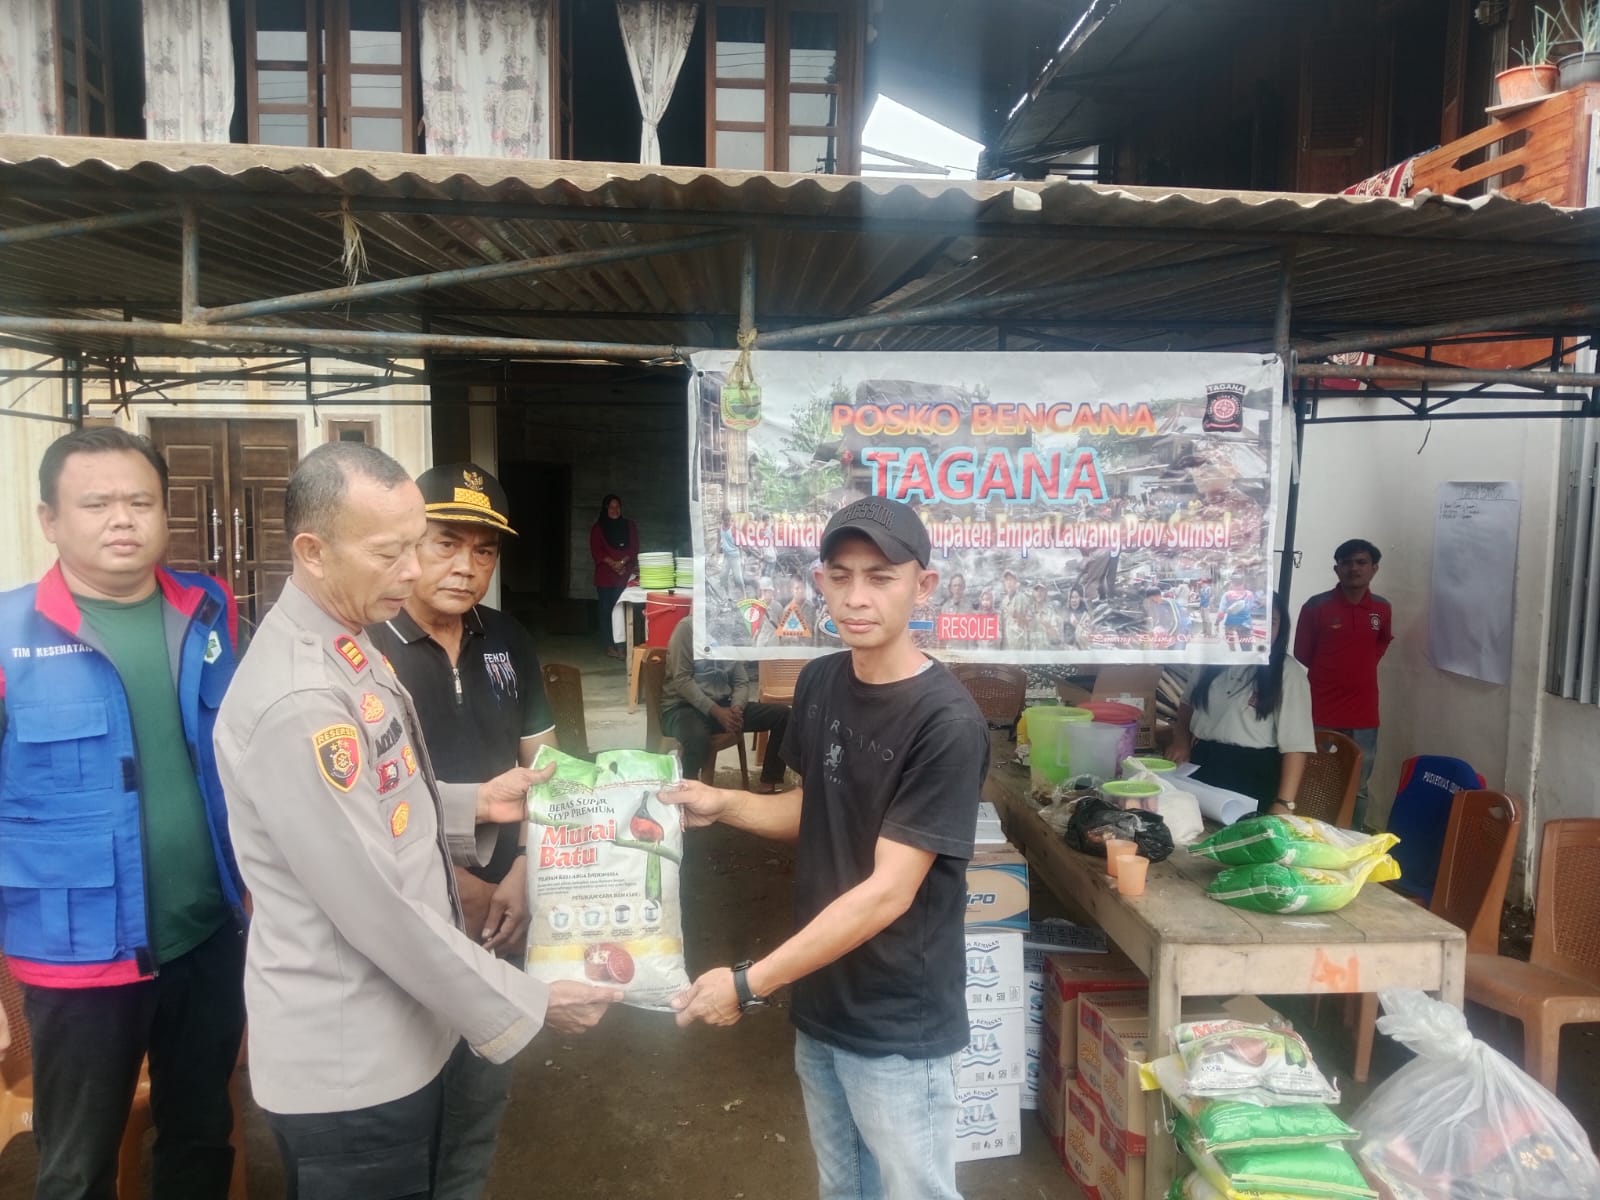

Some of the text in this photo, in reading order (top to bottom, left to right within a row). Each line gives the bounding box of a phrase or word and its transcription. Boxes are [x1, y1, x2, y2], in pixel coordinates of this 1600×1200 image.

[1207, 383, 1244, 392] TAGANA
[830, 402, 1157, 435] POSKO BENCANA
[863, 447, 1107, 503] TAGANA
[733, 513, 769, 548] Kec.
[995, 513, 1051, 558] Empat
[1055, 512, 1121, 557] Lawang
[1124, 513, 1166, 548] Prov
[1167, 511, 1232, 548] Sumsel
[941, 616, 995, 639] RESCUE
[12, 643, 93, 658] TIM KESEHATAN
[484, 651, 510, 664] FENDI
[549, 800, 574, 813] BERAS
[571, 805, 615, 818] PREMIUM
[541, 818, 617, 847] Murai
[538, 846, 597, 869] Batu
